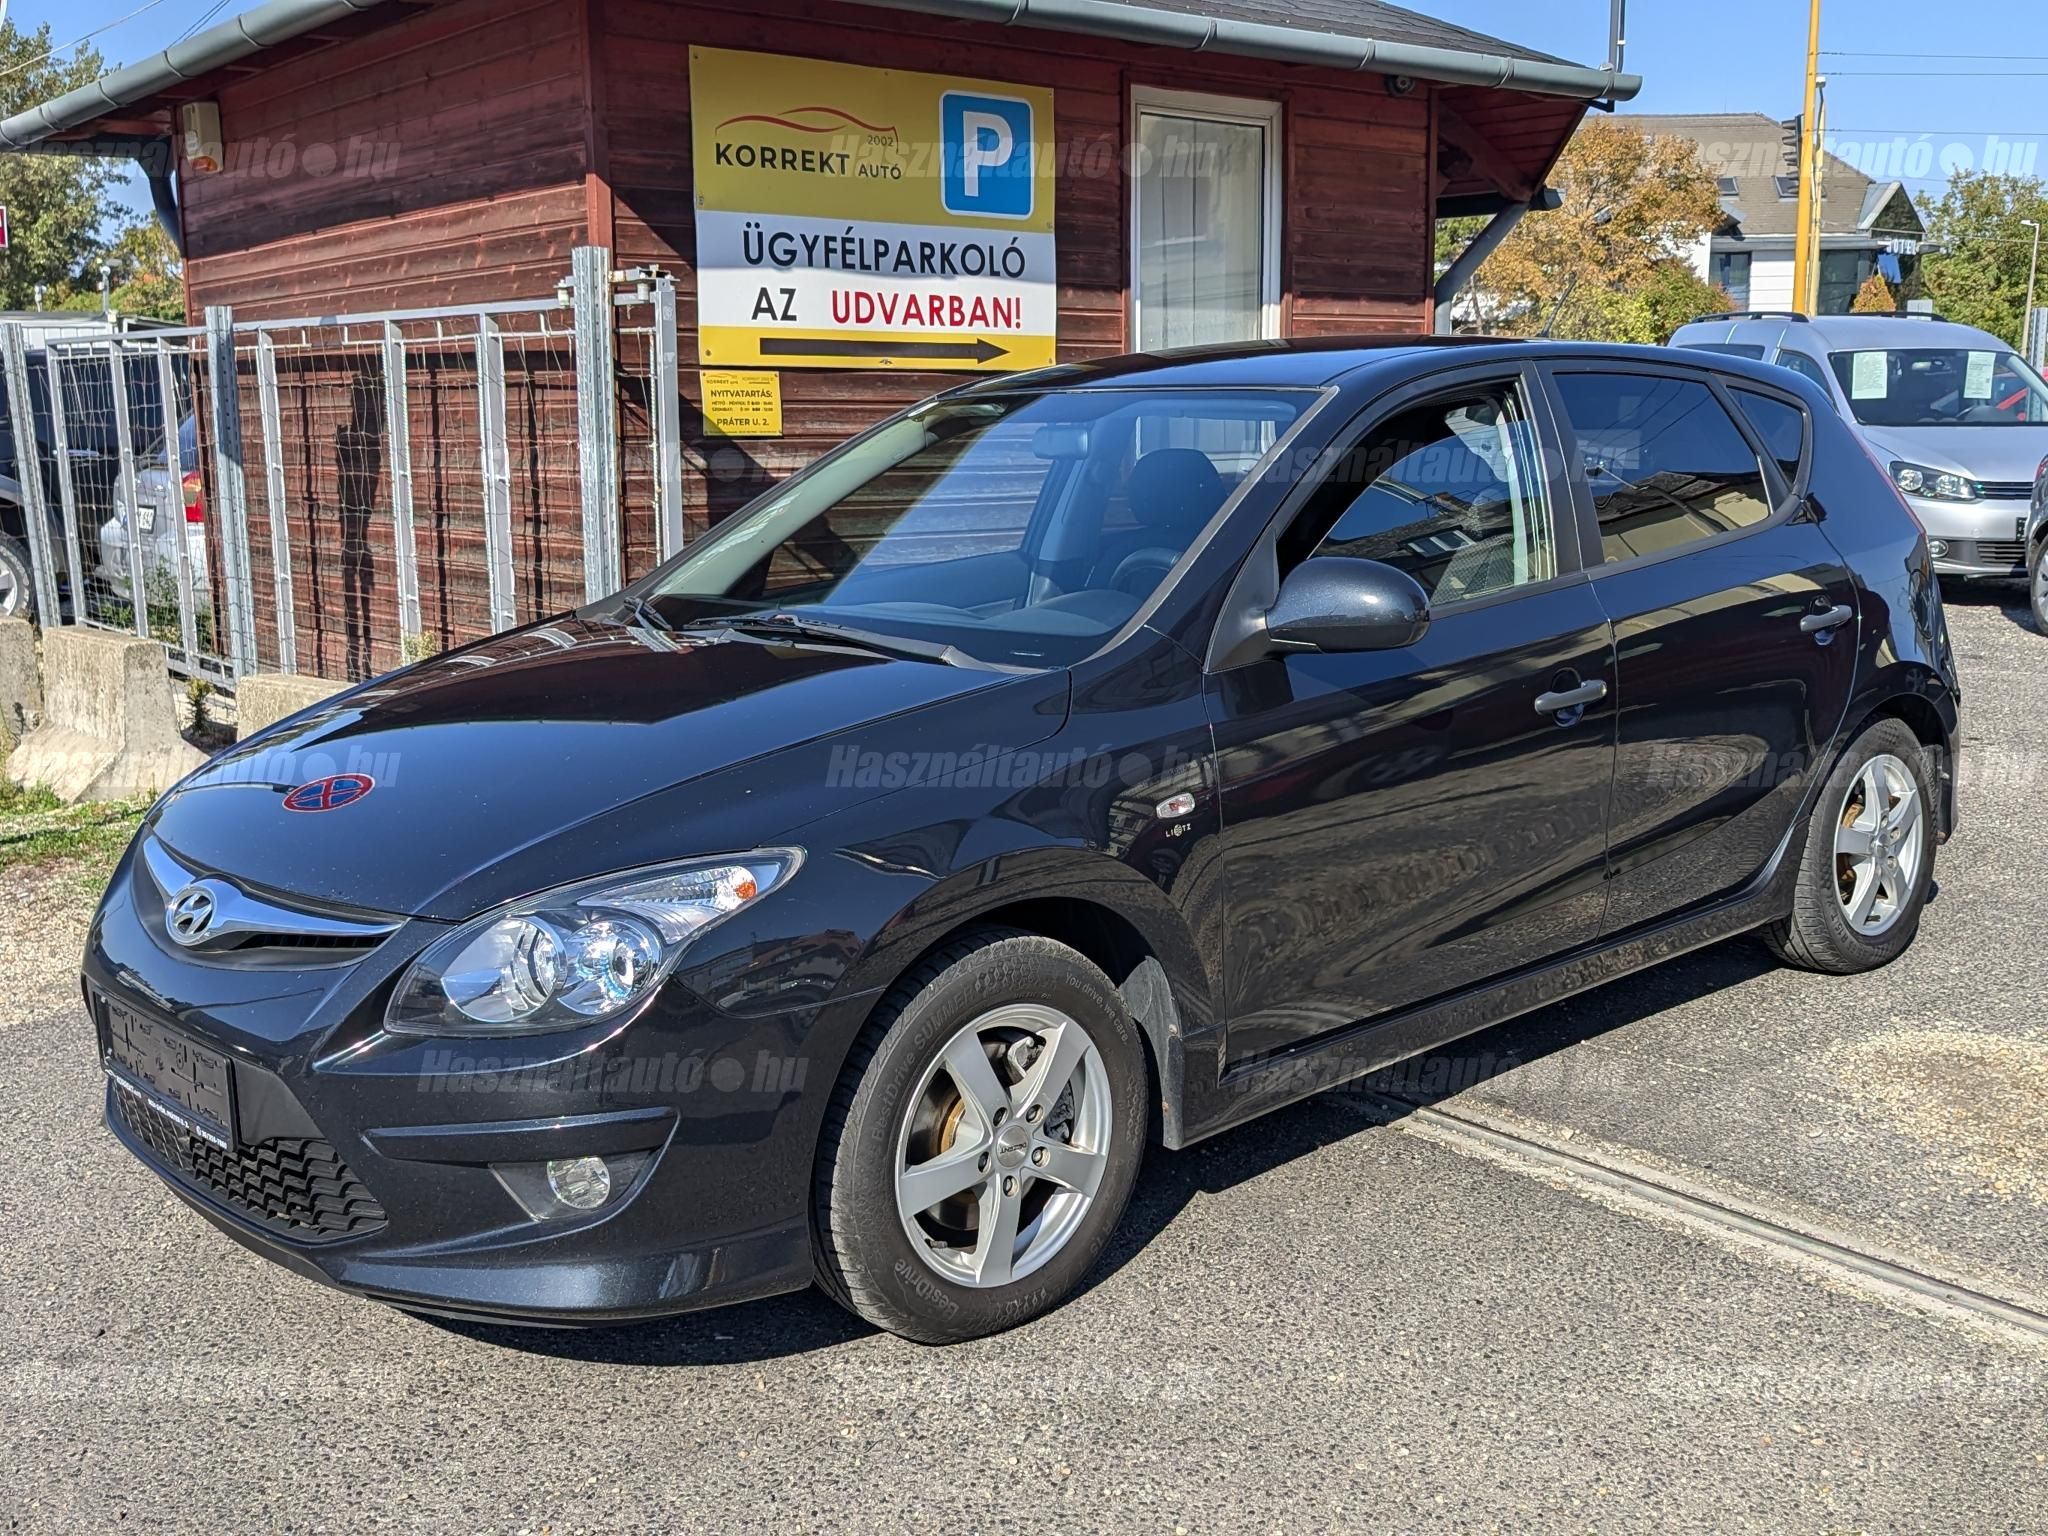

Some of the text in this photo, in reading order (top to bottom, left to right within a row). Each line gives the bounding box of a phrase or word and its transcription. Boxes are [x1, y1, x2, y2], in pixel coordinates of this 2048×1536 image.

[715, 142, 902, 180] KORREKT AUTÓ
[867, 135, 894, 147] 2002
[963, 111, 1013, 197] P
[742, 221, 1026, 279] ÜGYFÉLPARKOLÓ
[751, 287, 1022, 329] AZ UDVARBAN!
[710, 389, 773, 398] NYITVATARTÁS:
[716, 416, 750, 426] PRÁTER
[894, 1258, 960, 1321] BestDrive
